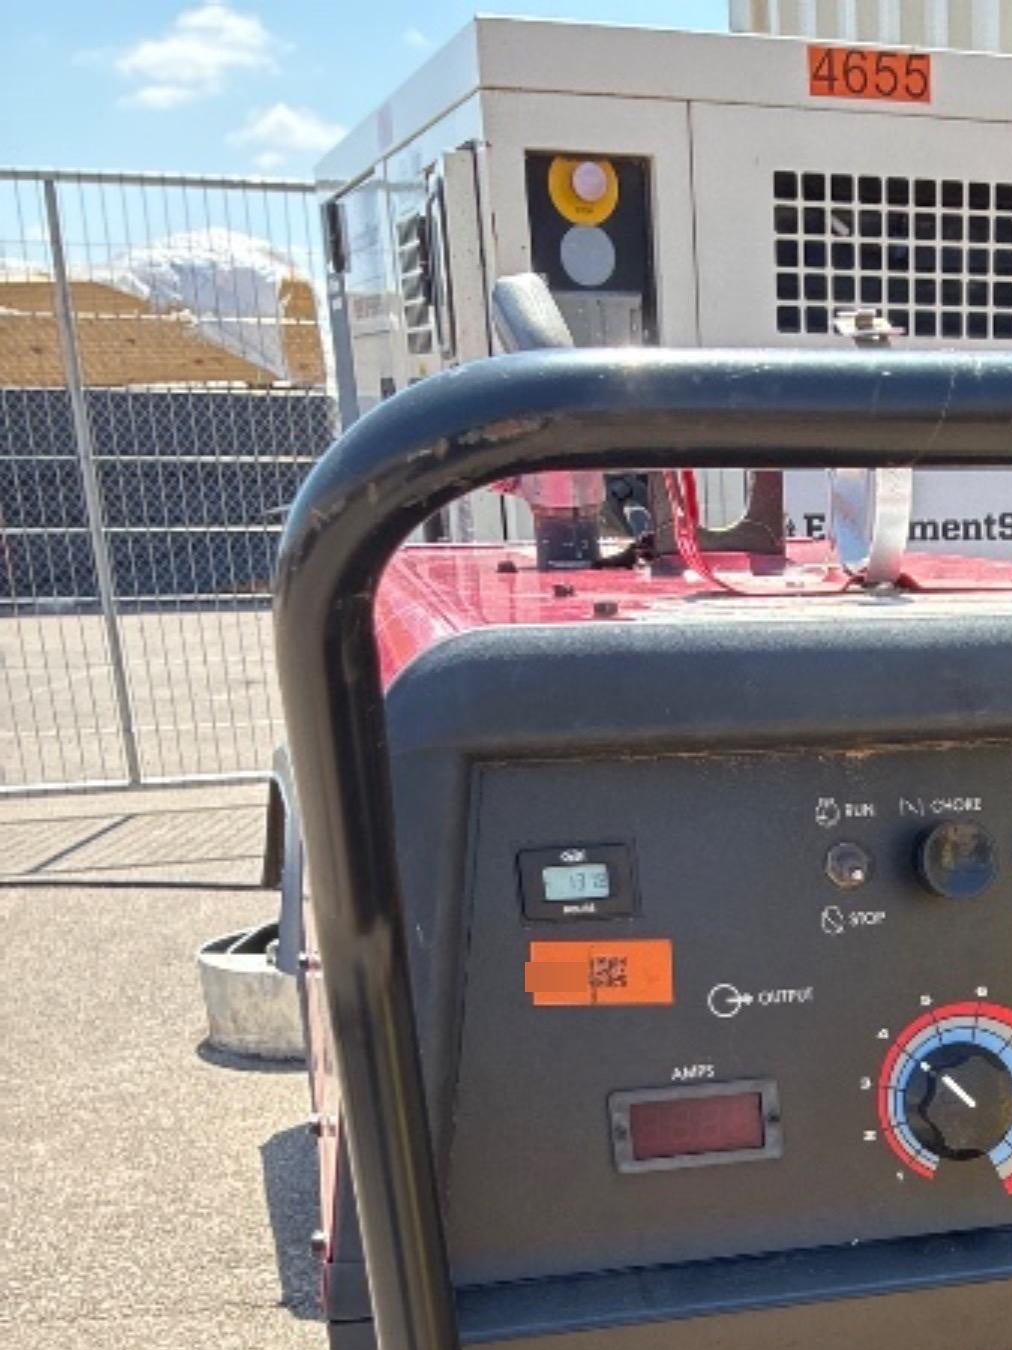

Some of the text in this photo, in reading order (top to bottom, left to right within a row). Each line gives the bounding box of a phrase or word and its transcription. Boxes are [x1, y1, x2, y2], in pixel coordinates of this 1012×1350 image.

[811, 47, 929, 98] 4655
[845, 802, 875, 818] RUN
[929, 796, 983, 814] CHOKE
[849, 910, 887, 927] STOP
[757, 986, 815, 1006] OUTPUT
[671, 1064, 716, 1081] AMPS
